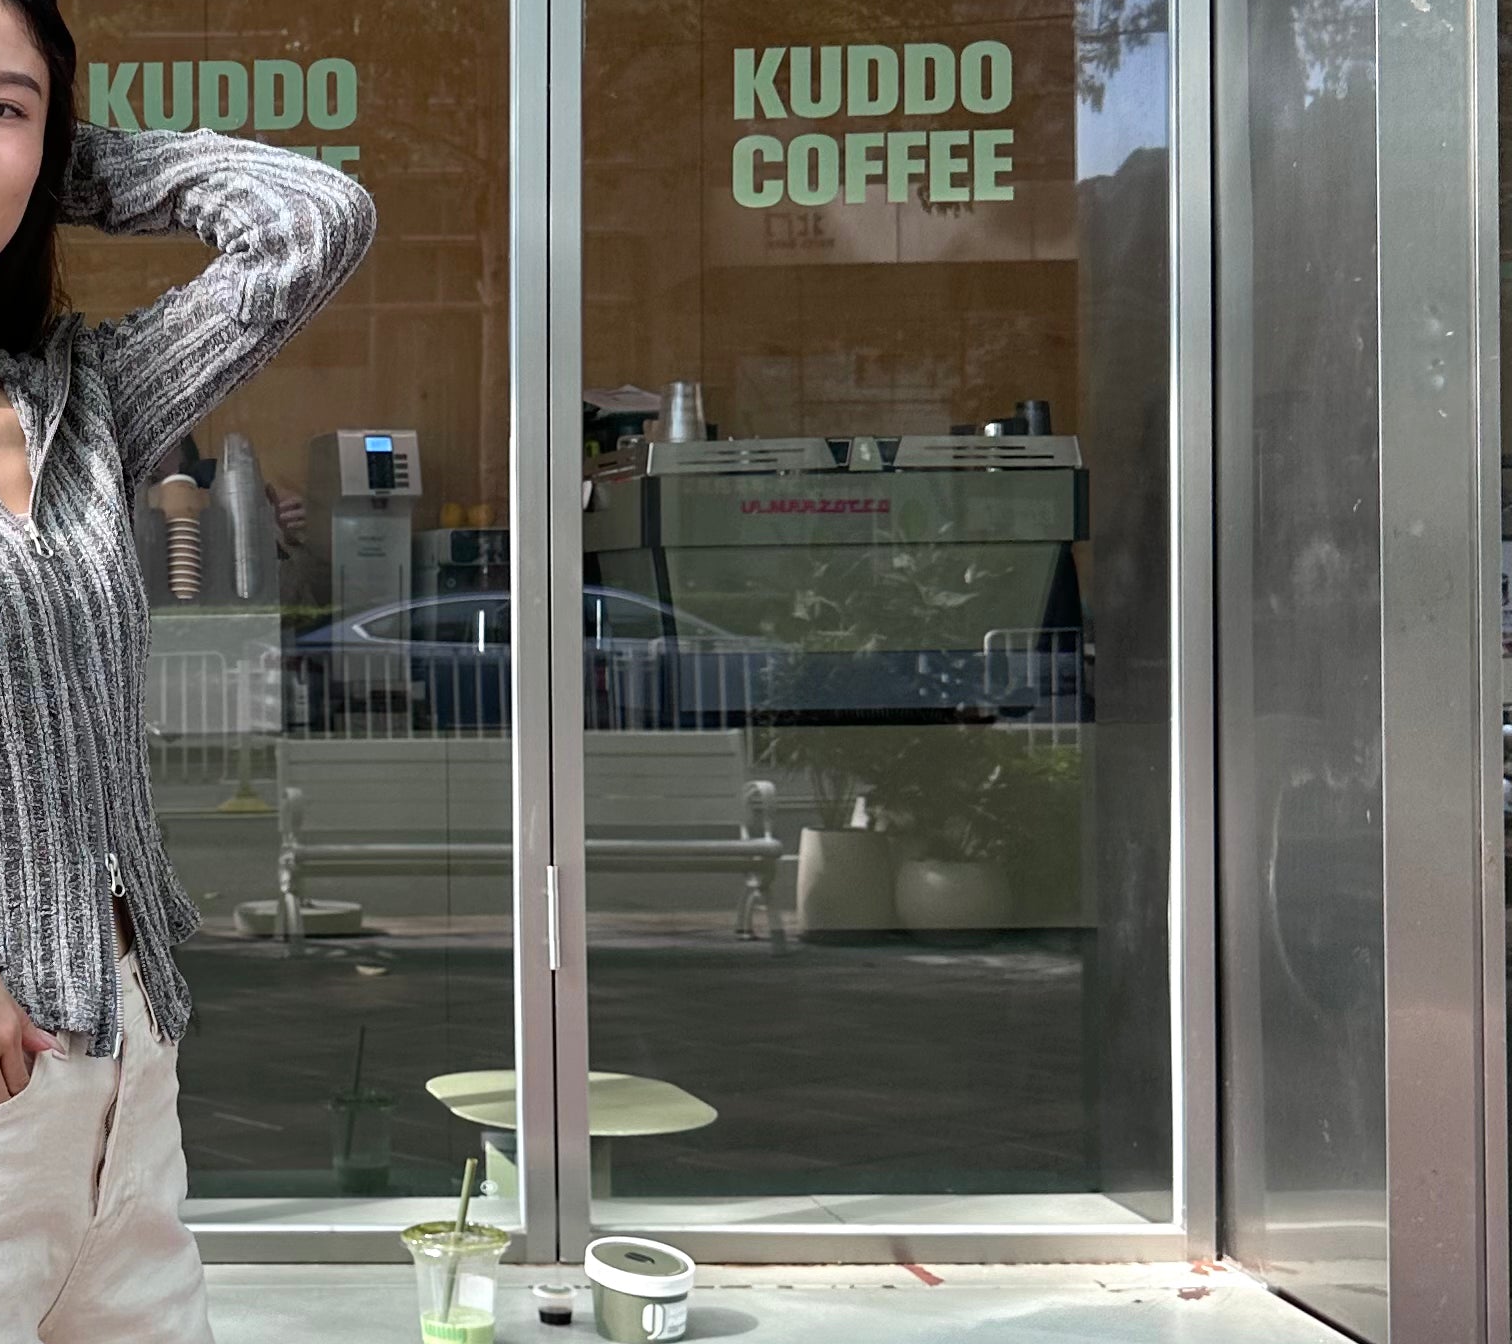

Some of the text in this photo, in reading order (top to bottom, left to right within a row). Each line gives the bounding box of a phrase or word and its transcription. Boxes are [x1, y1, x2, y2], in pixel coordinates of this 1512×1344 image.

[88, 57, 358, 132] KUDDO
[733, 40, 1013, 120] KUDDO
[732, 129, 1014, 208] COFFEE
